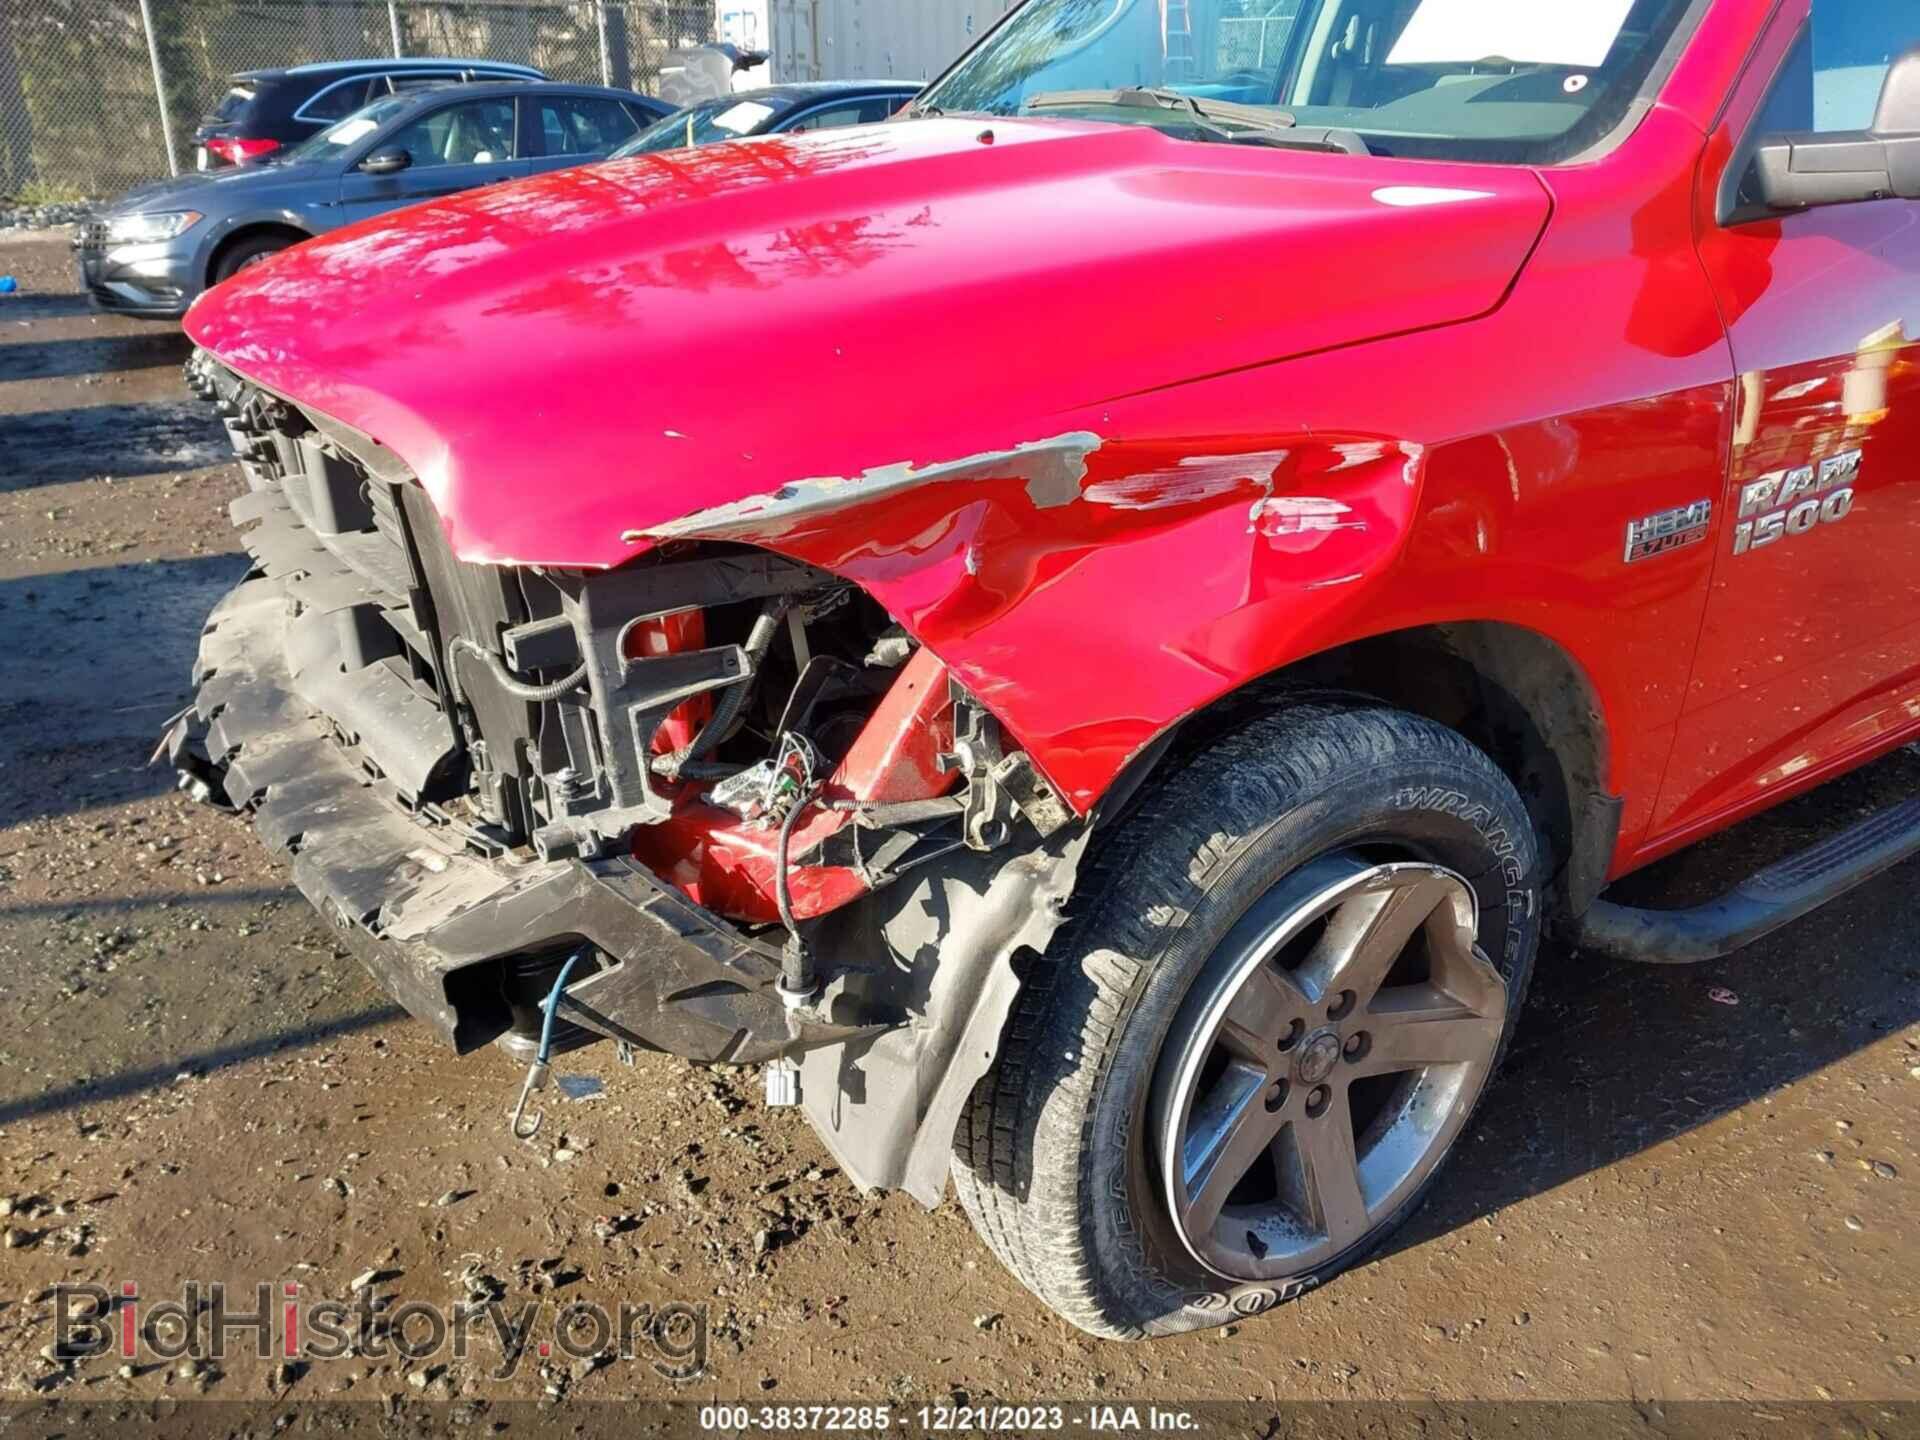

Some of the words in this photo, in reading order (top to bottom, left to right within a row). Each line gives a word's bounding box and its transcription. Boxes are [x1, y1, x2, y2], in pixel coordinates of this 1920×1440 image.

[1738, 448, 1863, 519] RAM
[1629, 499, 1711, 544] HEMI
[1733, 488, 1854, 556] 1500
